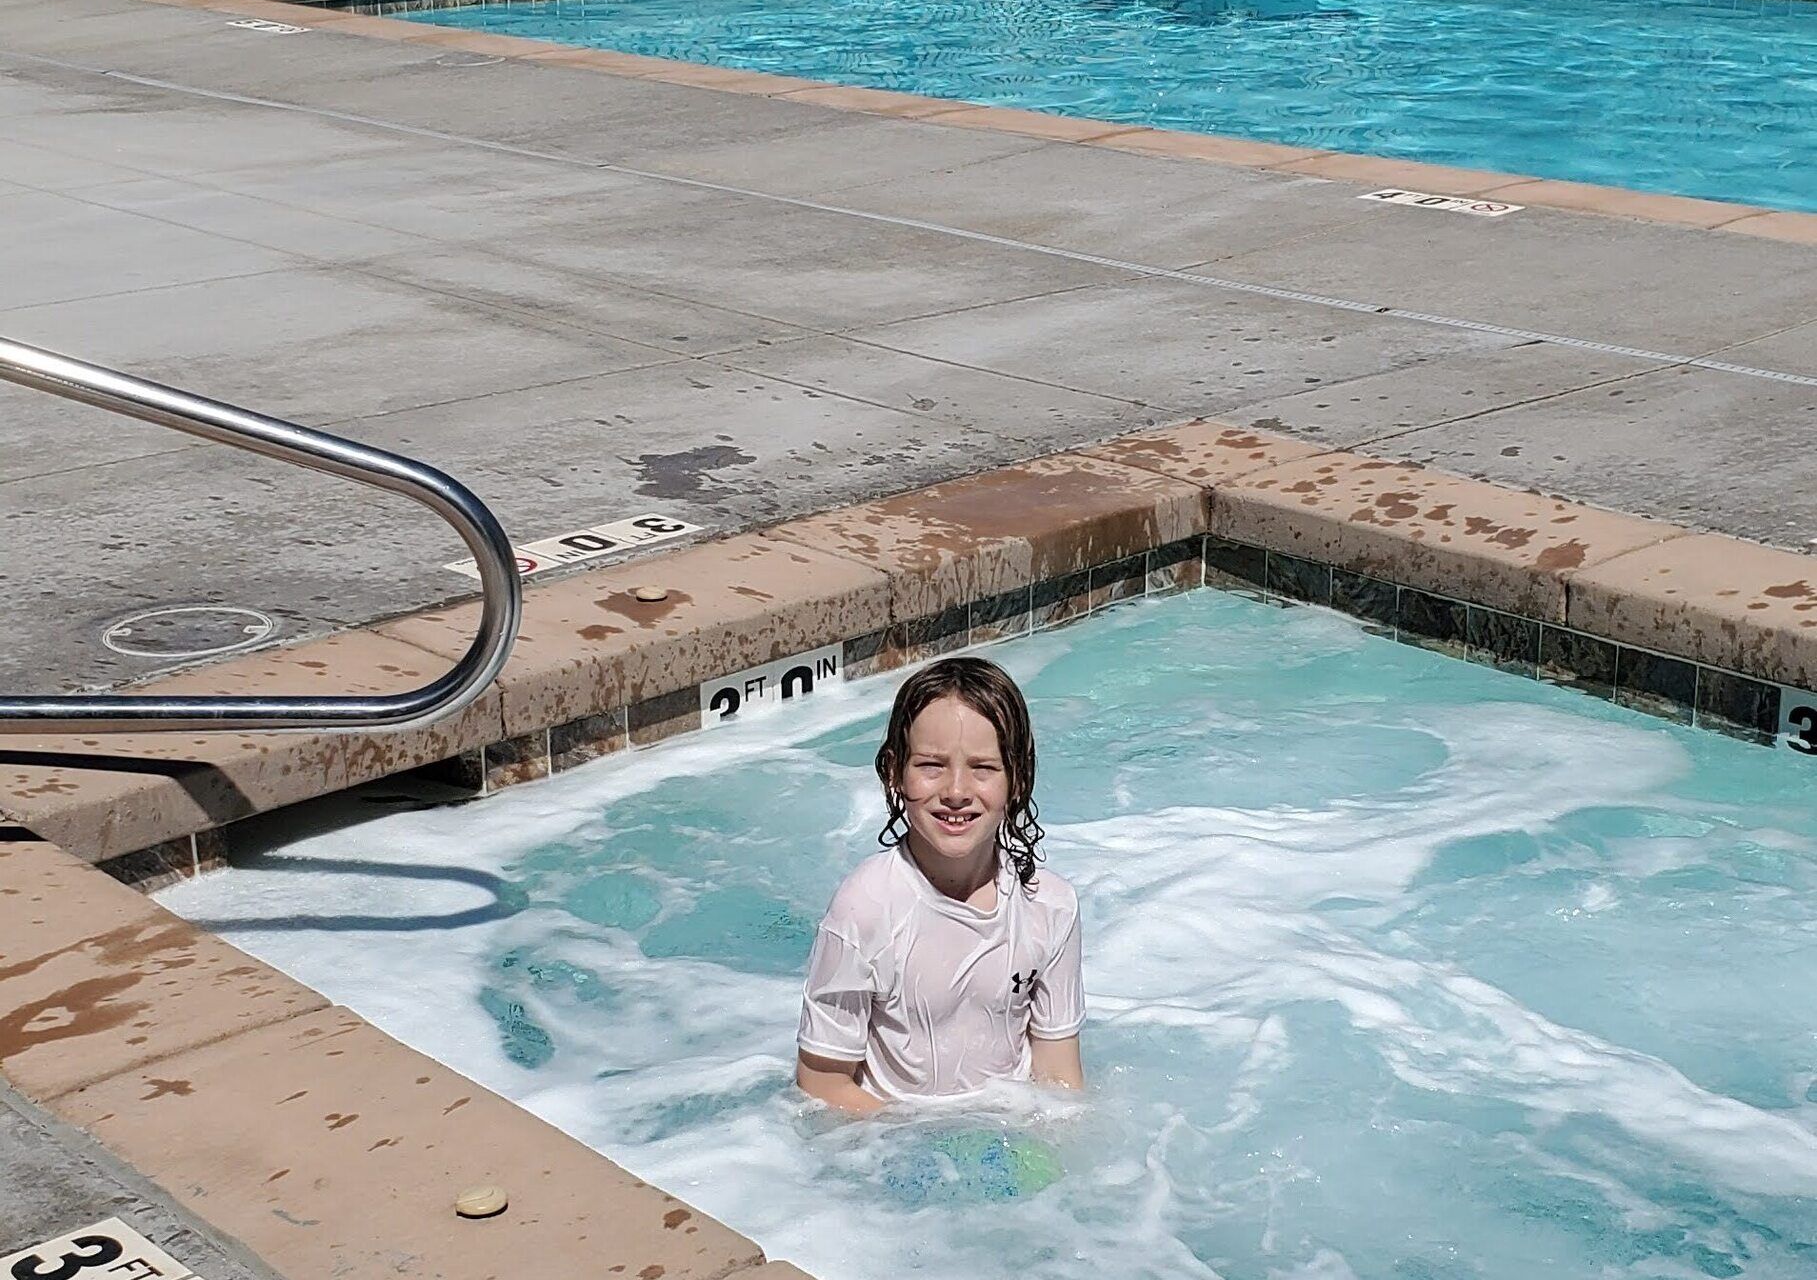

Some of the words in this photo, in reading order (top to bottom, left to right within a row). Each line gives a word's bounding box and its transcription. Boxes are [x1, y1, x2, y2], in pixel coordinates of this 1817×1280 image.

[1373, 192, 1405, 200] 4
[1415, 197, 1450, 206] 0
[632, 517, 685, 533] 3
[558, 534, 617, 551] 0
[635, 531, 657, 542] FT
[556, 549, 587, 560] IN
[745, 676, 767, 702] FT
[816, 655, 837, 681] IN
[1787, 706, 1817, 755] 3
